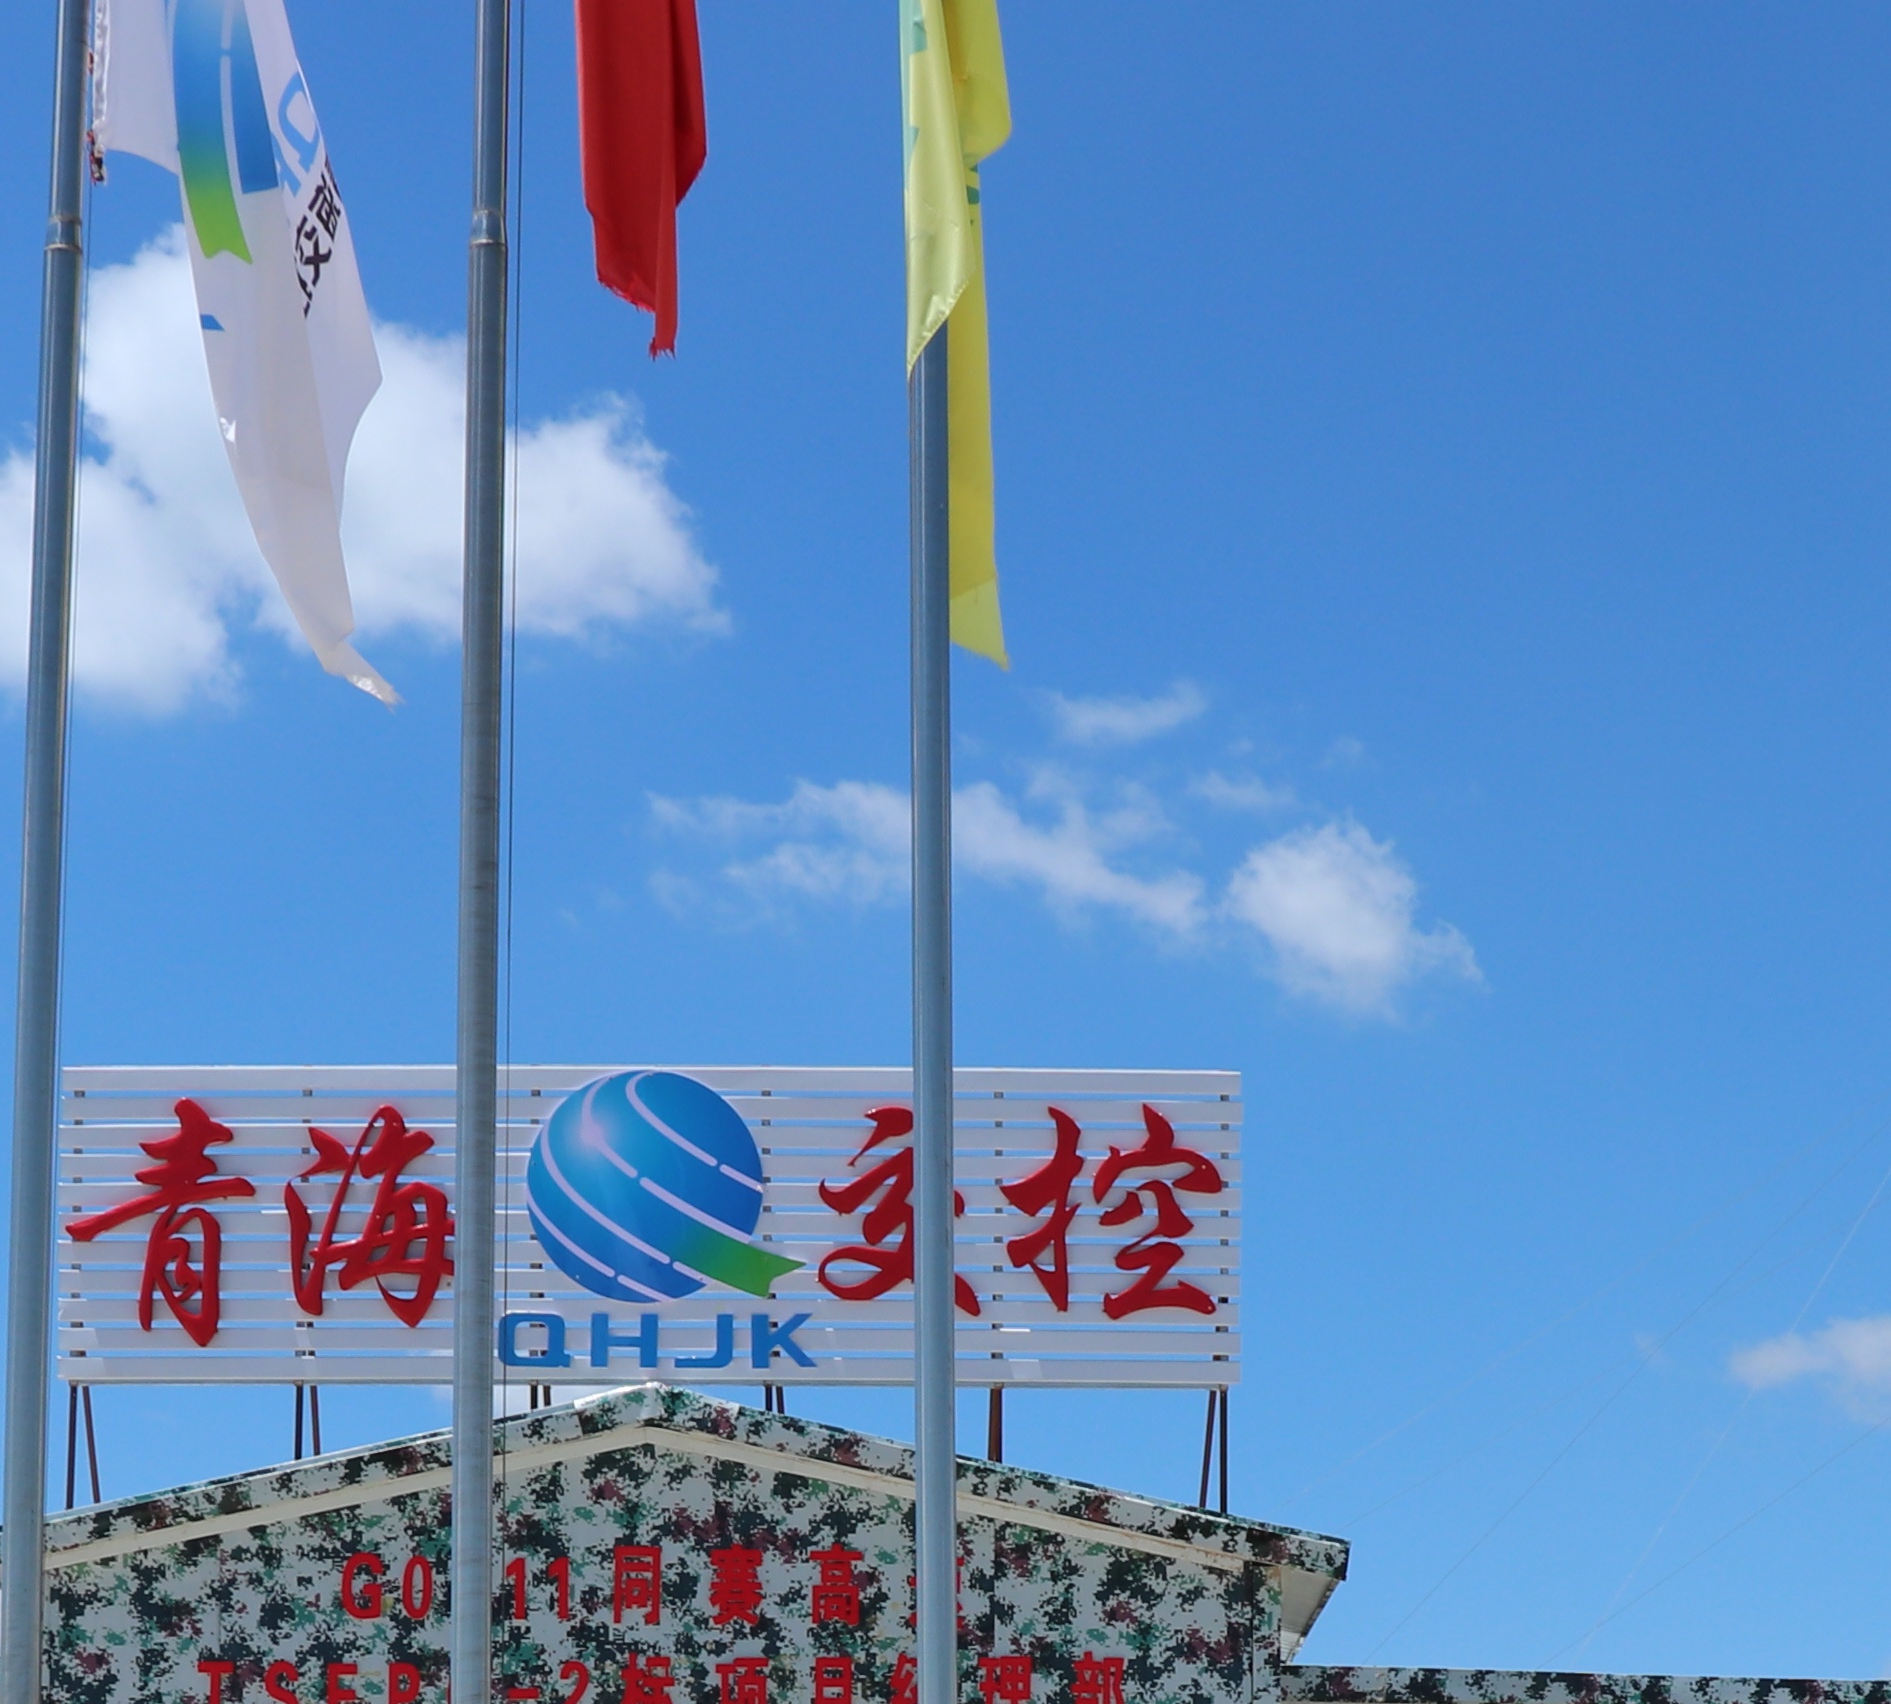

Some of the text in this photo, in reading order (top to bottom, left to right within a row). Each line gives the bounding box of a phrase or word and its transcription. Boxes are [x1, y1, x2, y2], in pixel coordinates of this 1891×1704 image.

[66, 1097, 1224, 1346] 青海 交控
[497, 1313, 818, 1370] QHJK
[340, 1545, 965, 1627] G011同赛高
